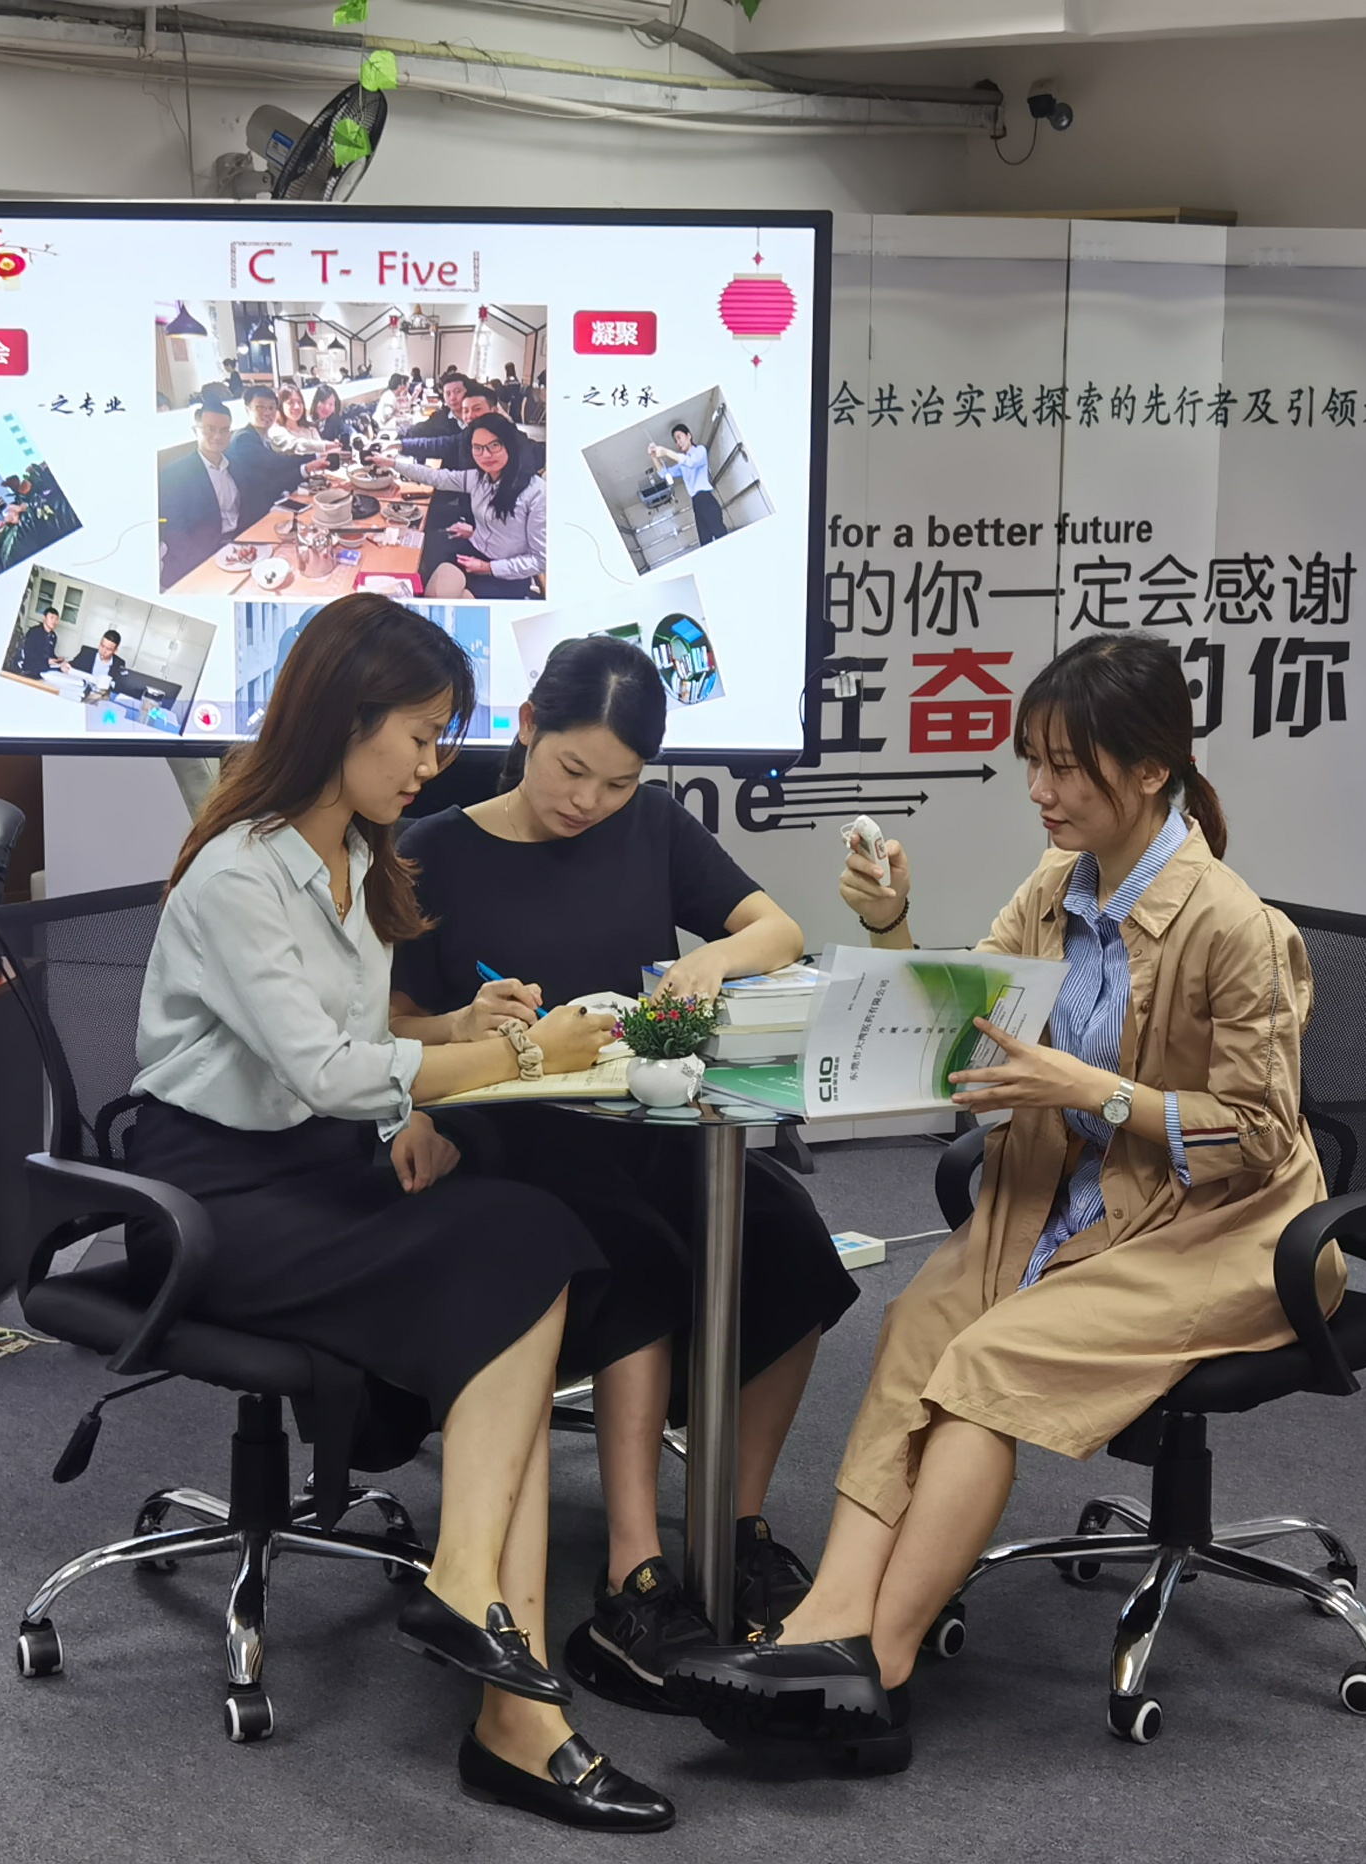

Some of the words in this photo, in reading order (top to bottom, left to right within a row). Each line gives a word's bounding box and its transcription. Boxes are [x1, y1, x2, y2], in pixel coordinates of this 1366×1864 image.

[378, 250, 458, 287] Five
[591, 320, 639, 346] 凝聚
[828, 514, 881, 548] for
[893, 524, 913, 547] a
[927, 515, 1043, 547] better
[1055, 512, 1153, 545] future
[825, 552, 1358, 638] 的你一定会感谢
[819, 1056, 833, 1102] CIO
